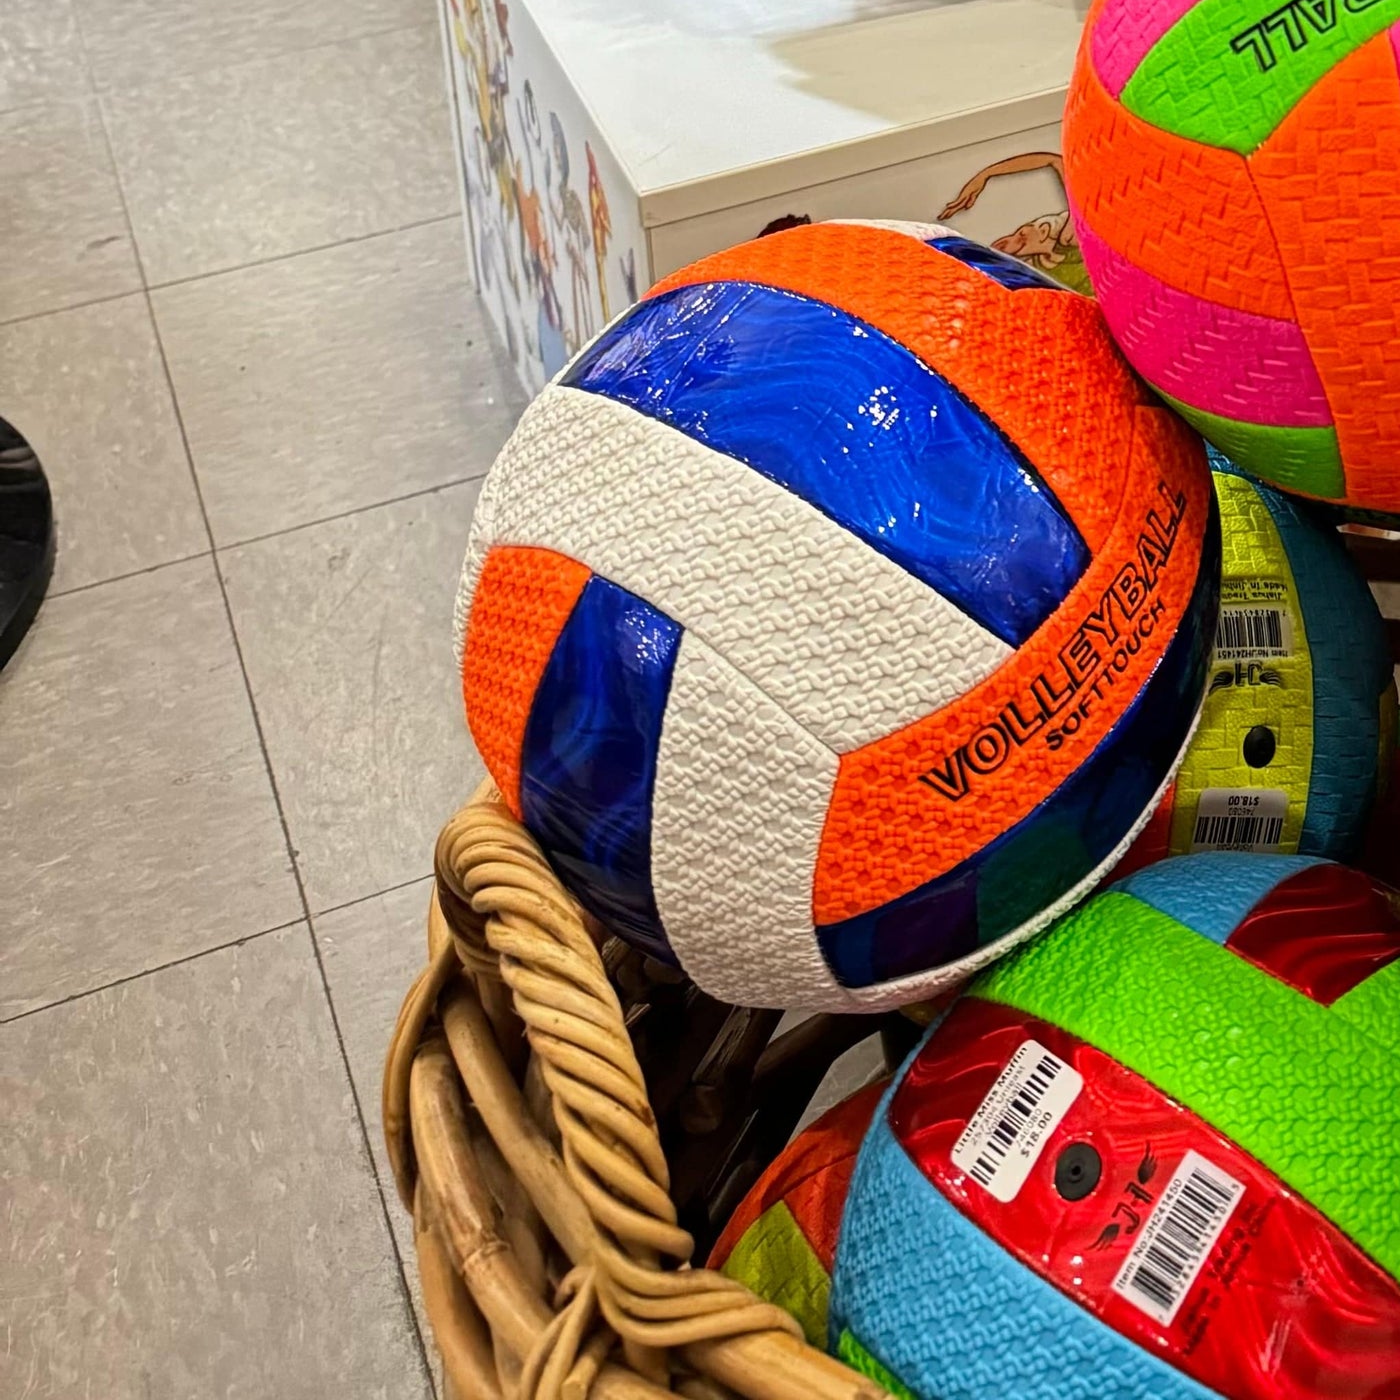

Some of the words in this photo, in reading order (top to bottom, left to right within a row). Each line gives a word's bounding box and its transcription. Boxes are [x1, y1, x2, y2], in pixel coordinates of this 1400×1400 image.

[918, 481, 1188, 802] VOLLEYBALL
[1045, 599, 1167, 751] SOFTTOUCH
[1228, 795, 1260, 806] $18.00
[955, 1121, 979, 1154] Little
[977, 1089, 999, 1118] Miss
[997, 1047, 1028, 1087] Muffin
[1020, 1111, 1053, 1159] $18.00
[1116, 1260, 1136, 1290] Item
[1133, 1177, 1183, 1258] No:JH241450
